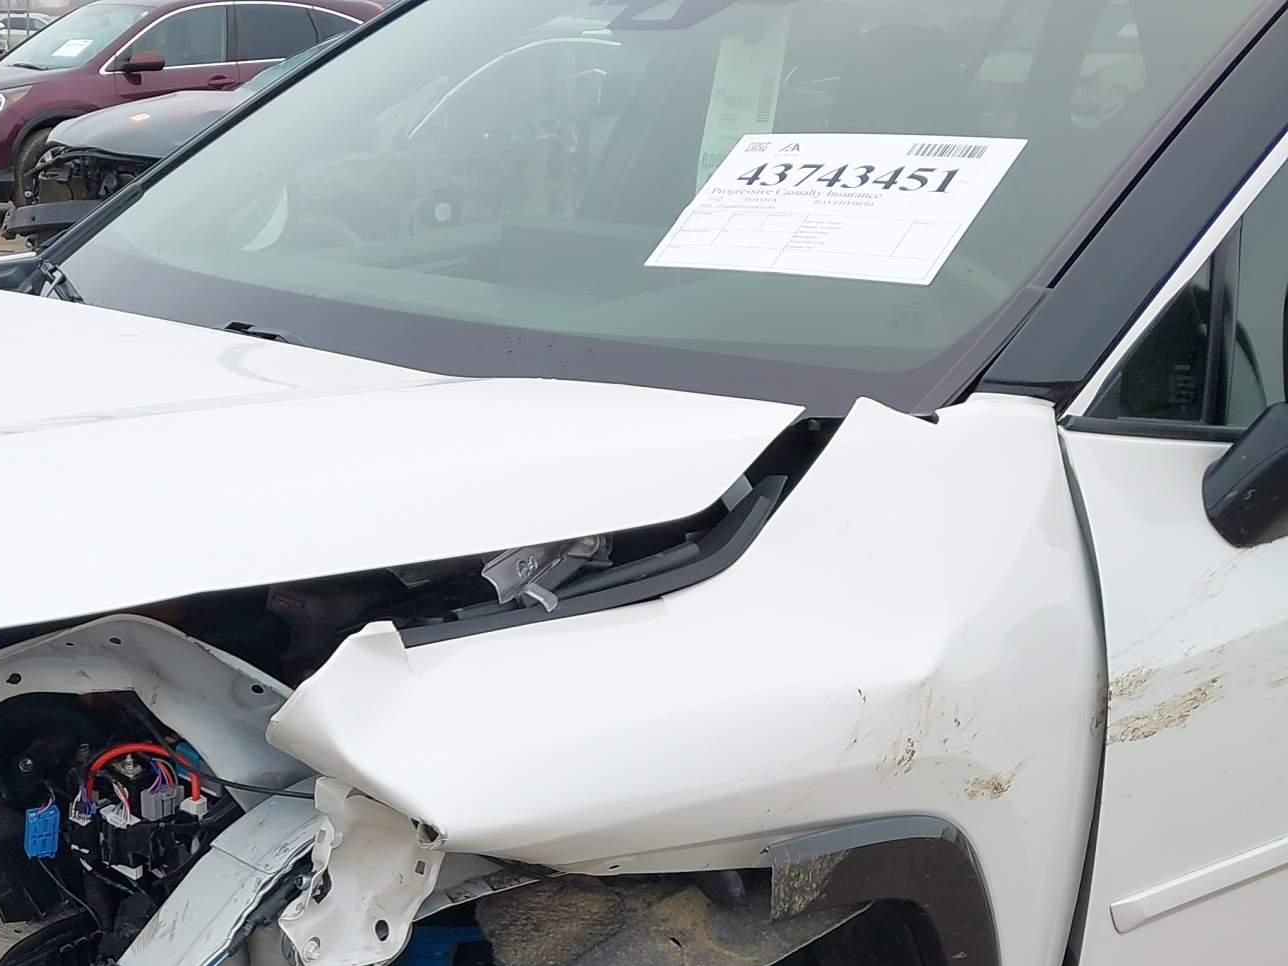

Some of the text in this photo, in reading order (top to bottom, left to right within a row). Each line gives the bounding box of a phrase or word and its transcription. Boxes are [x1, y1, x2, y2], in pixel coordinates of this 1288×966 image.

[736, 162, 960, 194] 43743451
[711, 187, 883, 200] Progressive Casualty Insurance
